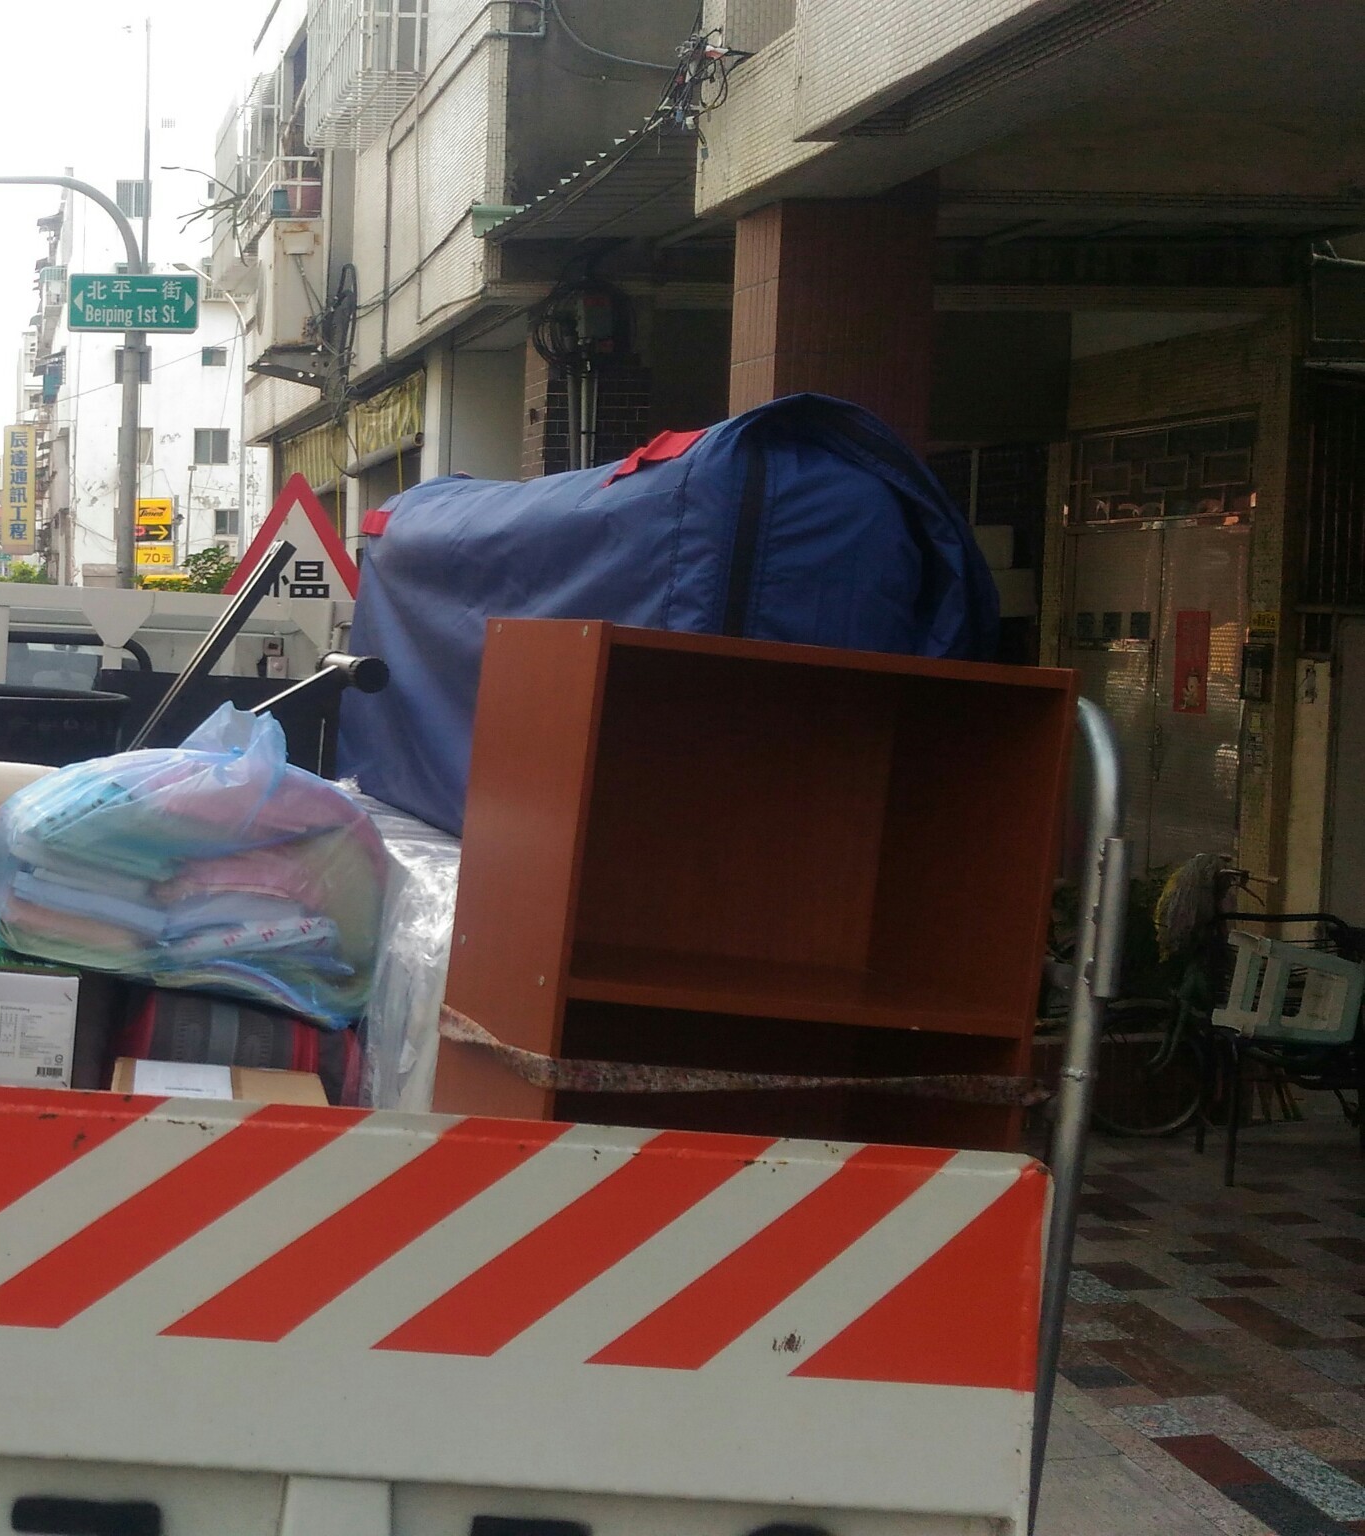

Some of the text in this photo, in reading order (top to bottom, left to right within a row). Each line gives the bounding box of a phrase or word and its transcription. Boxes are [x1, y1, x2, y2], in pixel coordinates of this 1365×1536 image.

[86, 280, 182, 301] 北平一街
[85, 304, 180, 327] Beiping 1st St.
[9, 431, 28, 541] 辰達通訊工程
[143, 553, 171, 564] 70元
